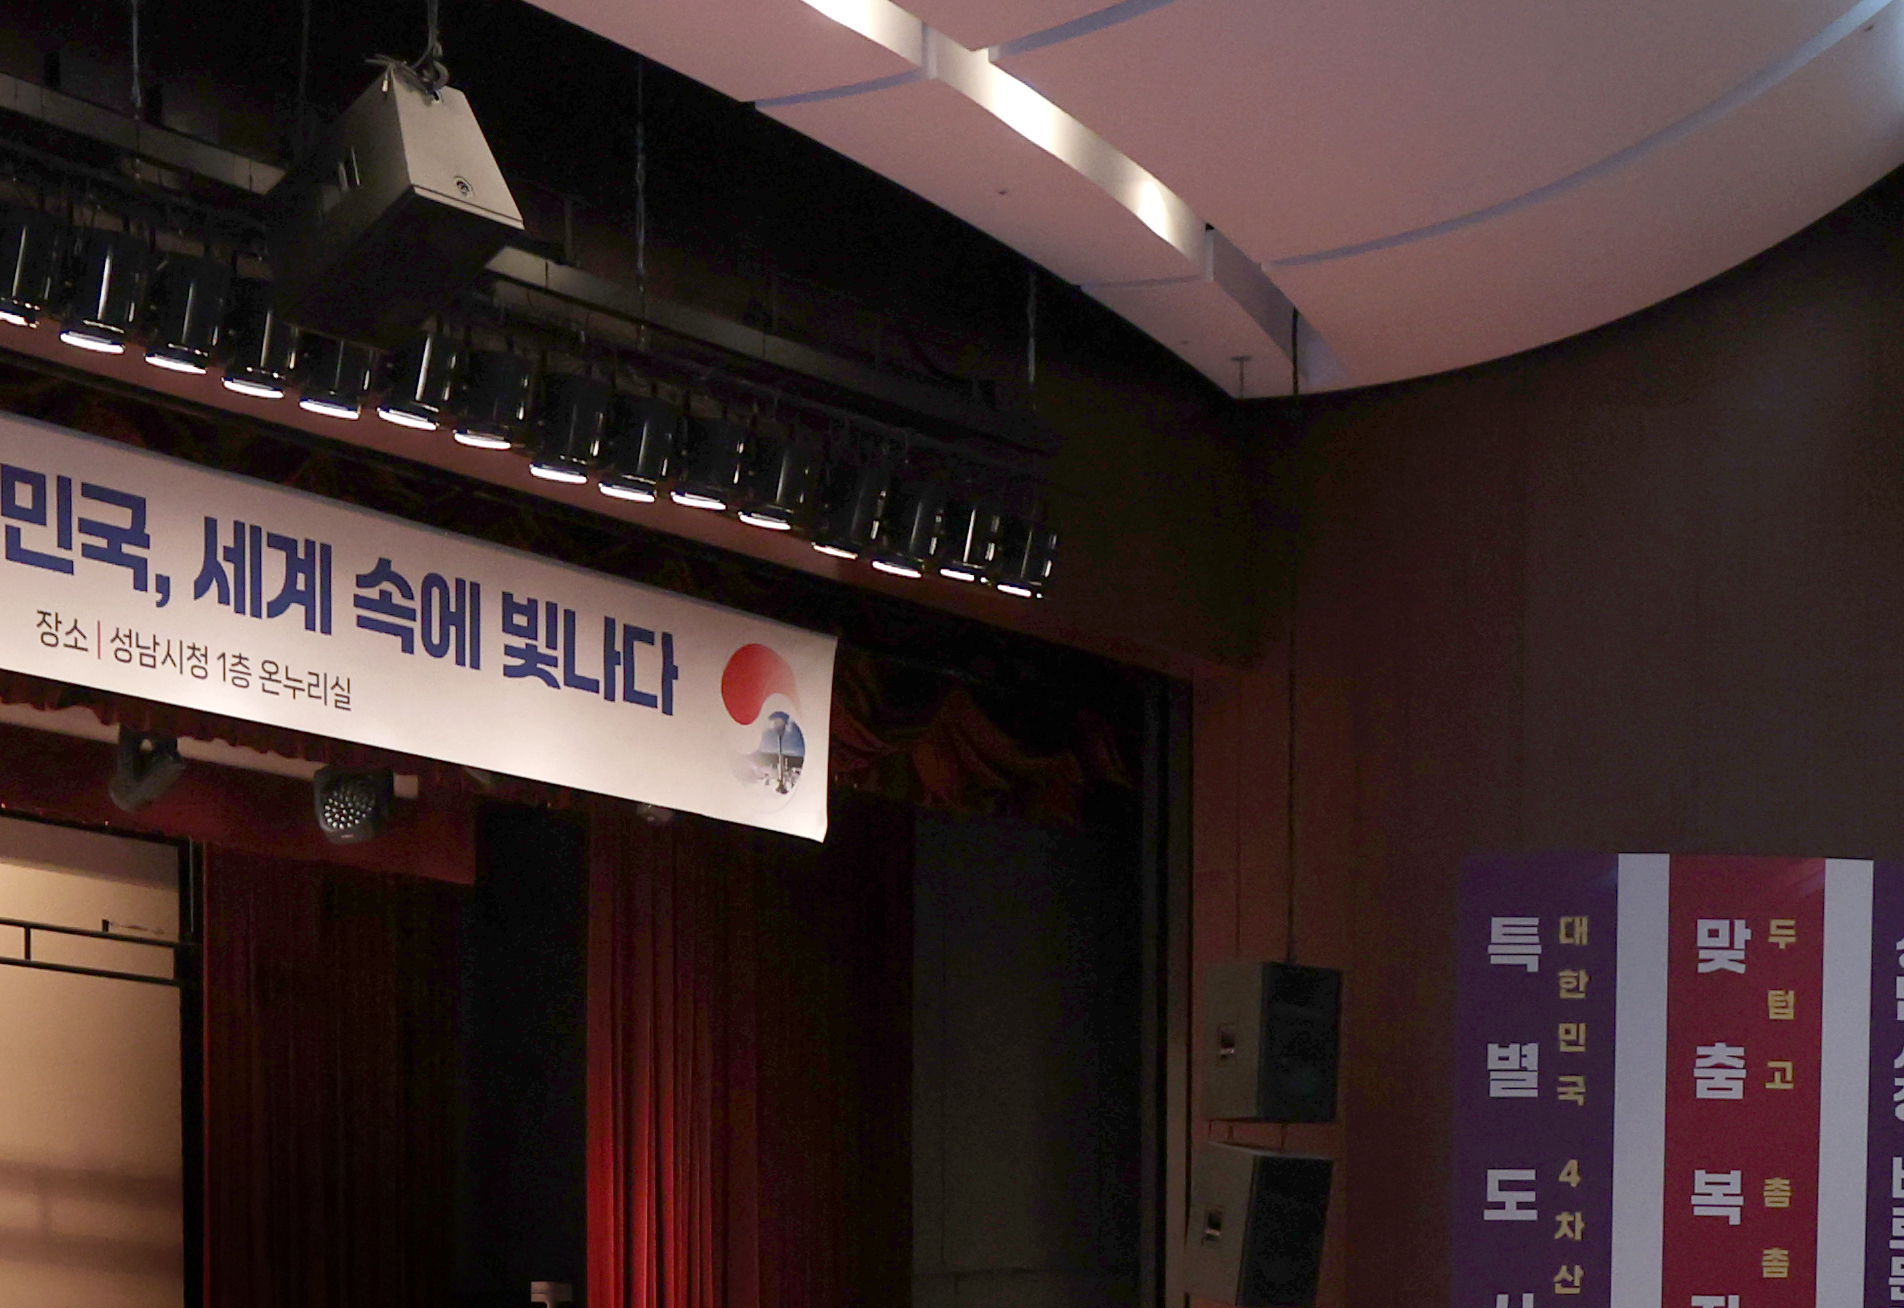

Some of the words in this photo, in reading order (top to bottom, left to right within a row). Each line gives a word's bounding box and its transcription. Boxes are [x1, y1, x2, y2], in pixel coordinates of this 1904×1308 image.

[36, 610, 88, 652] 장소
[111, 628, 207, 679] 성남시청
[217, 652, 251, 688] 1층
[259, 660, 351, 711] 온누리실
[194, 516, 332, 636] 세계
[353, 557, 480, 670] 속에
[502, 591, 678, 716] 빛나다
[1557, 917, 1588, 1105] 대한민국
